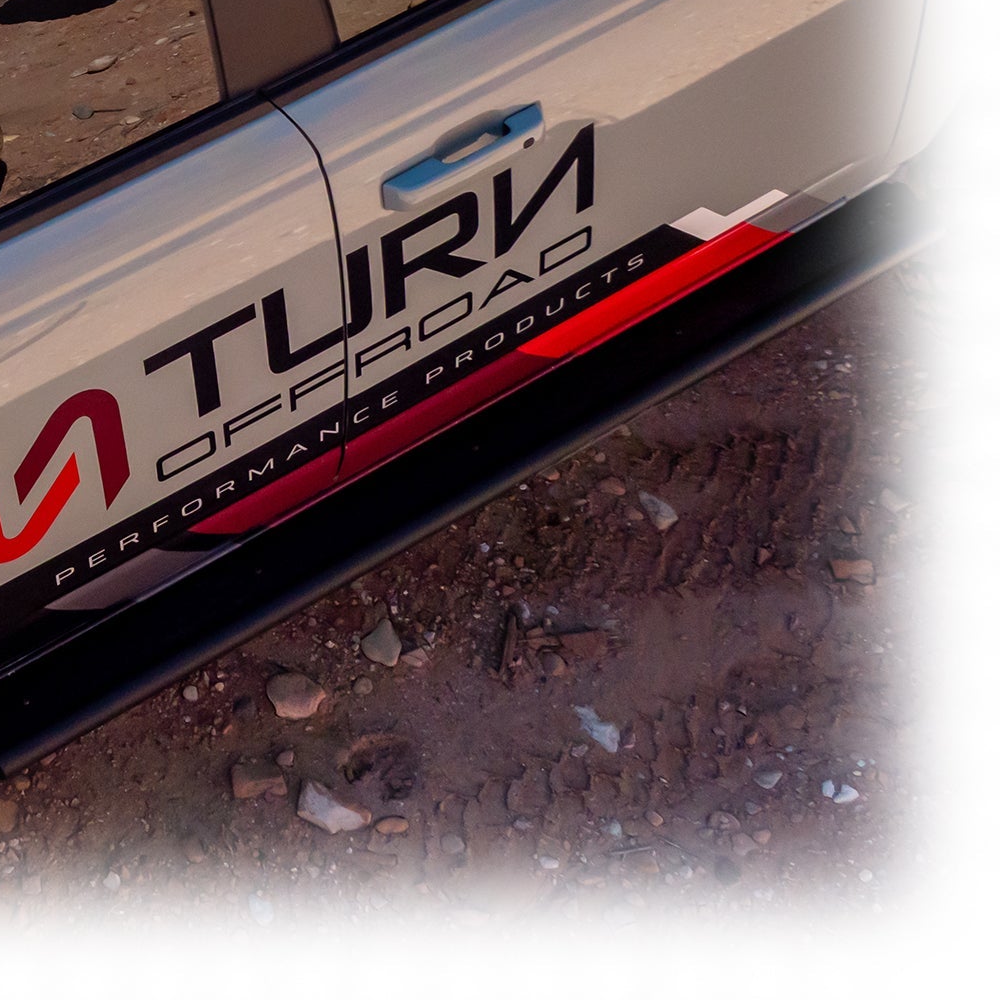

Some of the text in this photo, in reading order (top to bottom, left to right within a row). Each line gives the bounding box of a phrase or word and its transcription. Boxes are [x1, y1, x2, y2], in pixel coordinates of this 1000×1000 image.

[143, 123, 595, 418] TURN
[156, 226, 592, 483] OFFROAD
[55, 253, 646, 586] PERFORMANCE PRODUCTS
